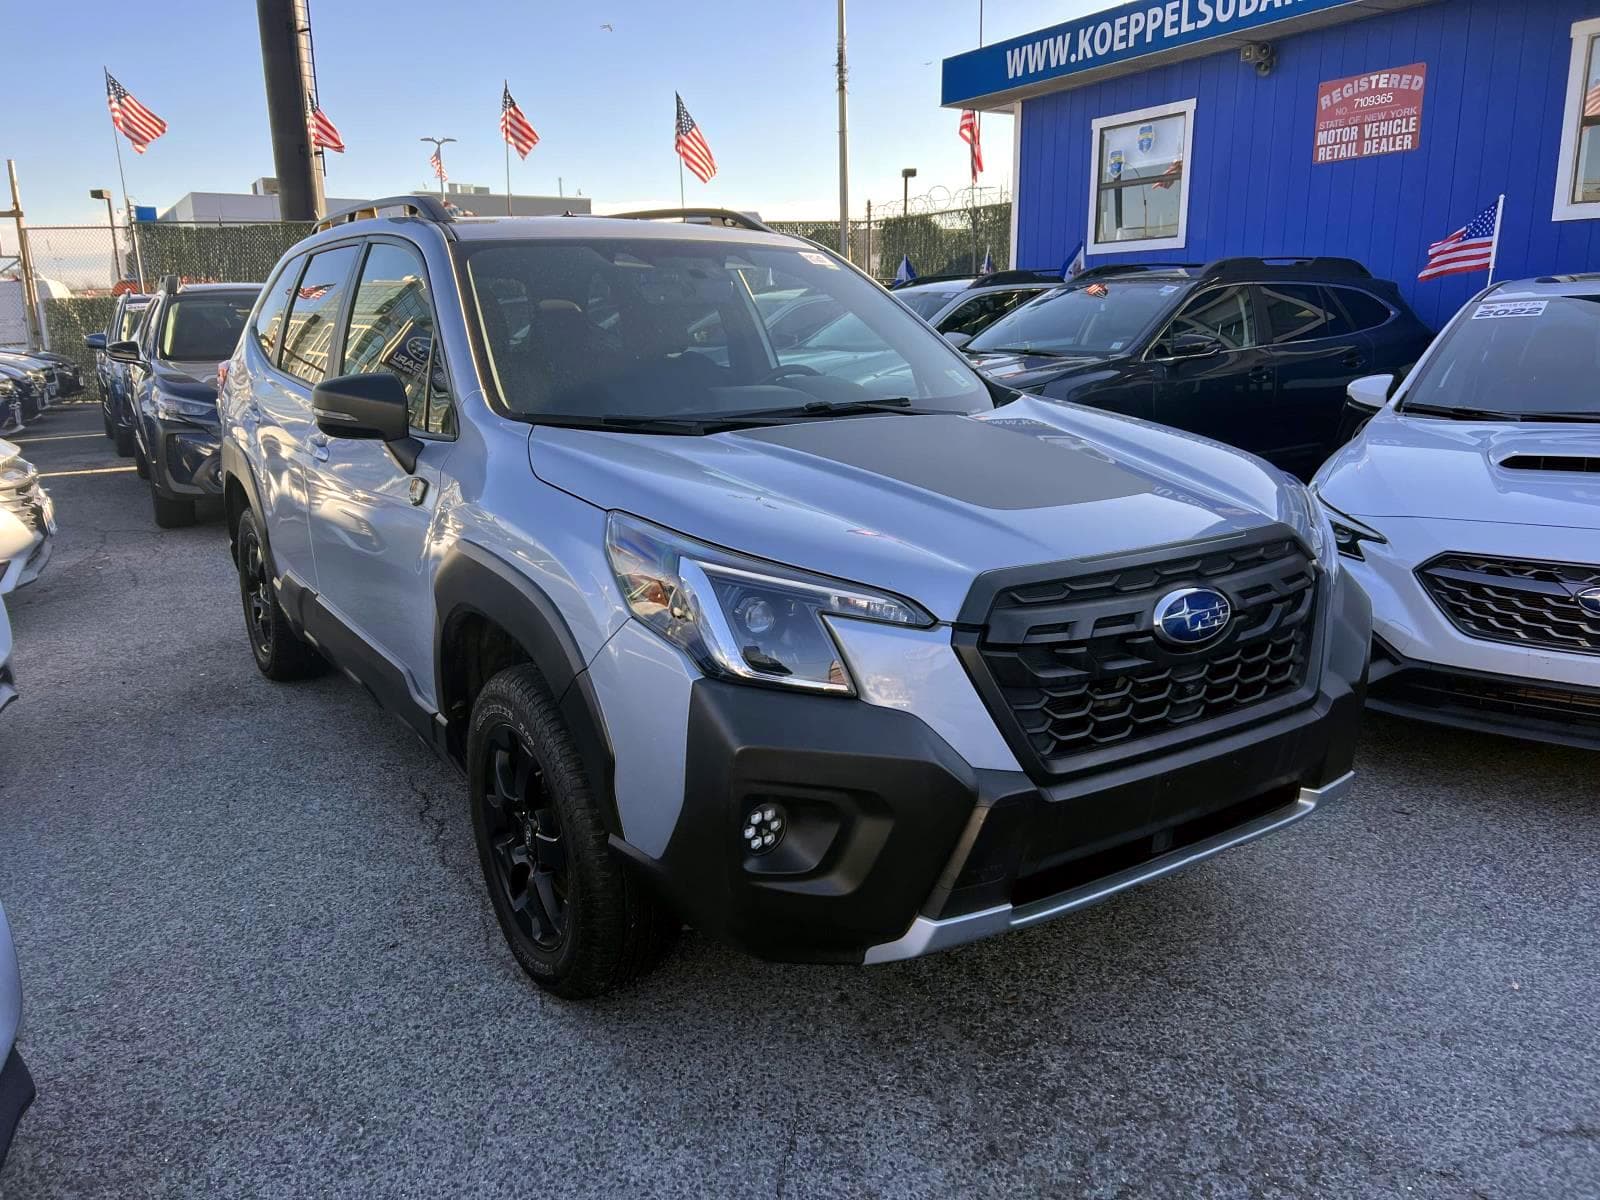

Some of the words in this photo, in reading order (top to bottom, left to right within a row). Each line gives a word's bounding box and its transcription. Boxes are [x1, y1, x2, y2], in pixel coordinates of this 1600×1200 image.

[1006, 0, 1303, 79] WWW.KOEPPELSUB
[1320, 73, 1424, 111] REGISTERED
[1353, 92, 1393, 109] 7109365
[1317, 125, 1358, 146] MOTOR
[1364, 116, 1417, 139] VEHICLE
[1319, 118, 1345, 130] STATE
[1348, 116, 1361, 126] OF
[1364, 111, 1387, 123] NEW
[1390, 106, 1417, 118] YORK
[1318, 141, 1358, 162] RETAIL
[1363, 134, 1412, 155] DEALER
